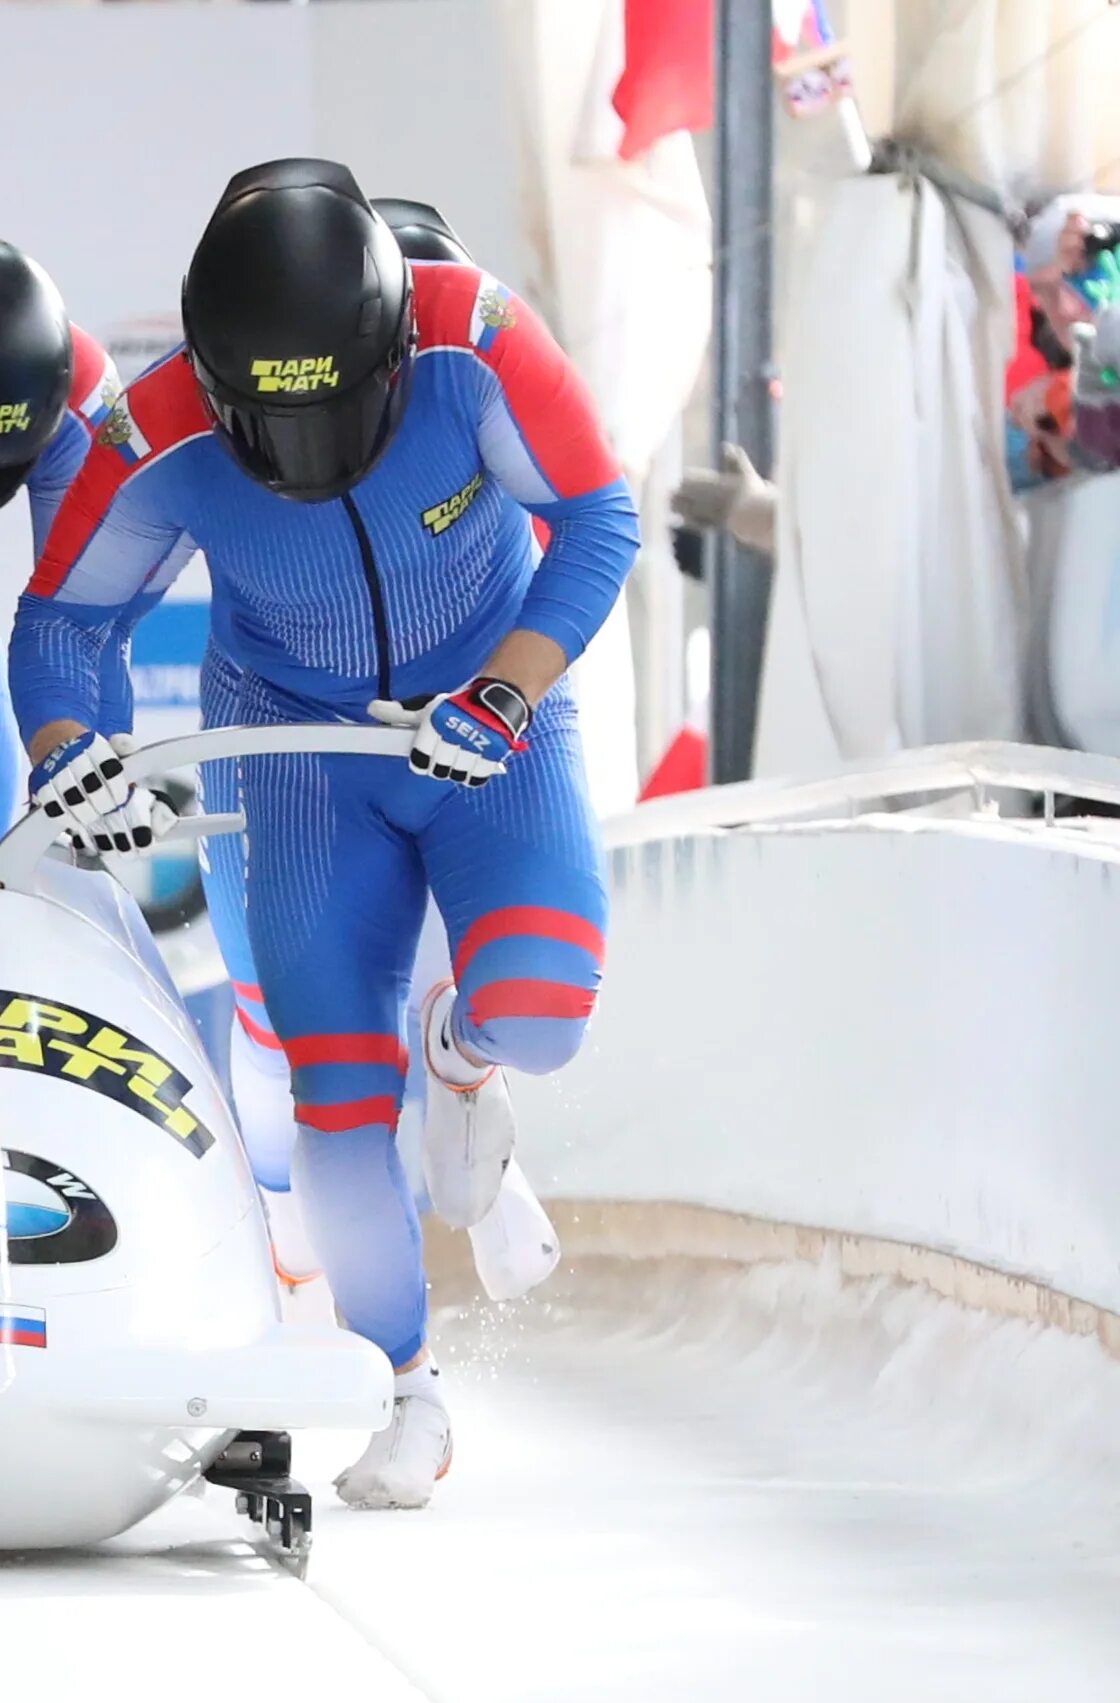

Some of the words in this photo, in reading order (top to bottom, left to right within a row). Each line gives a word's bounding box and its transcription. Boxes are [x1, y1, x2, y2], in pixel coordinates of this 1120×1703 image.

[250, 356, 333, 377] ПАРИ
[257, 371, 340, 392] МАТЧ
[445, 716, 491, 752] SEIZ
